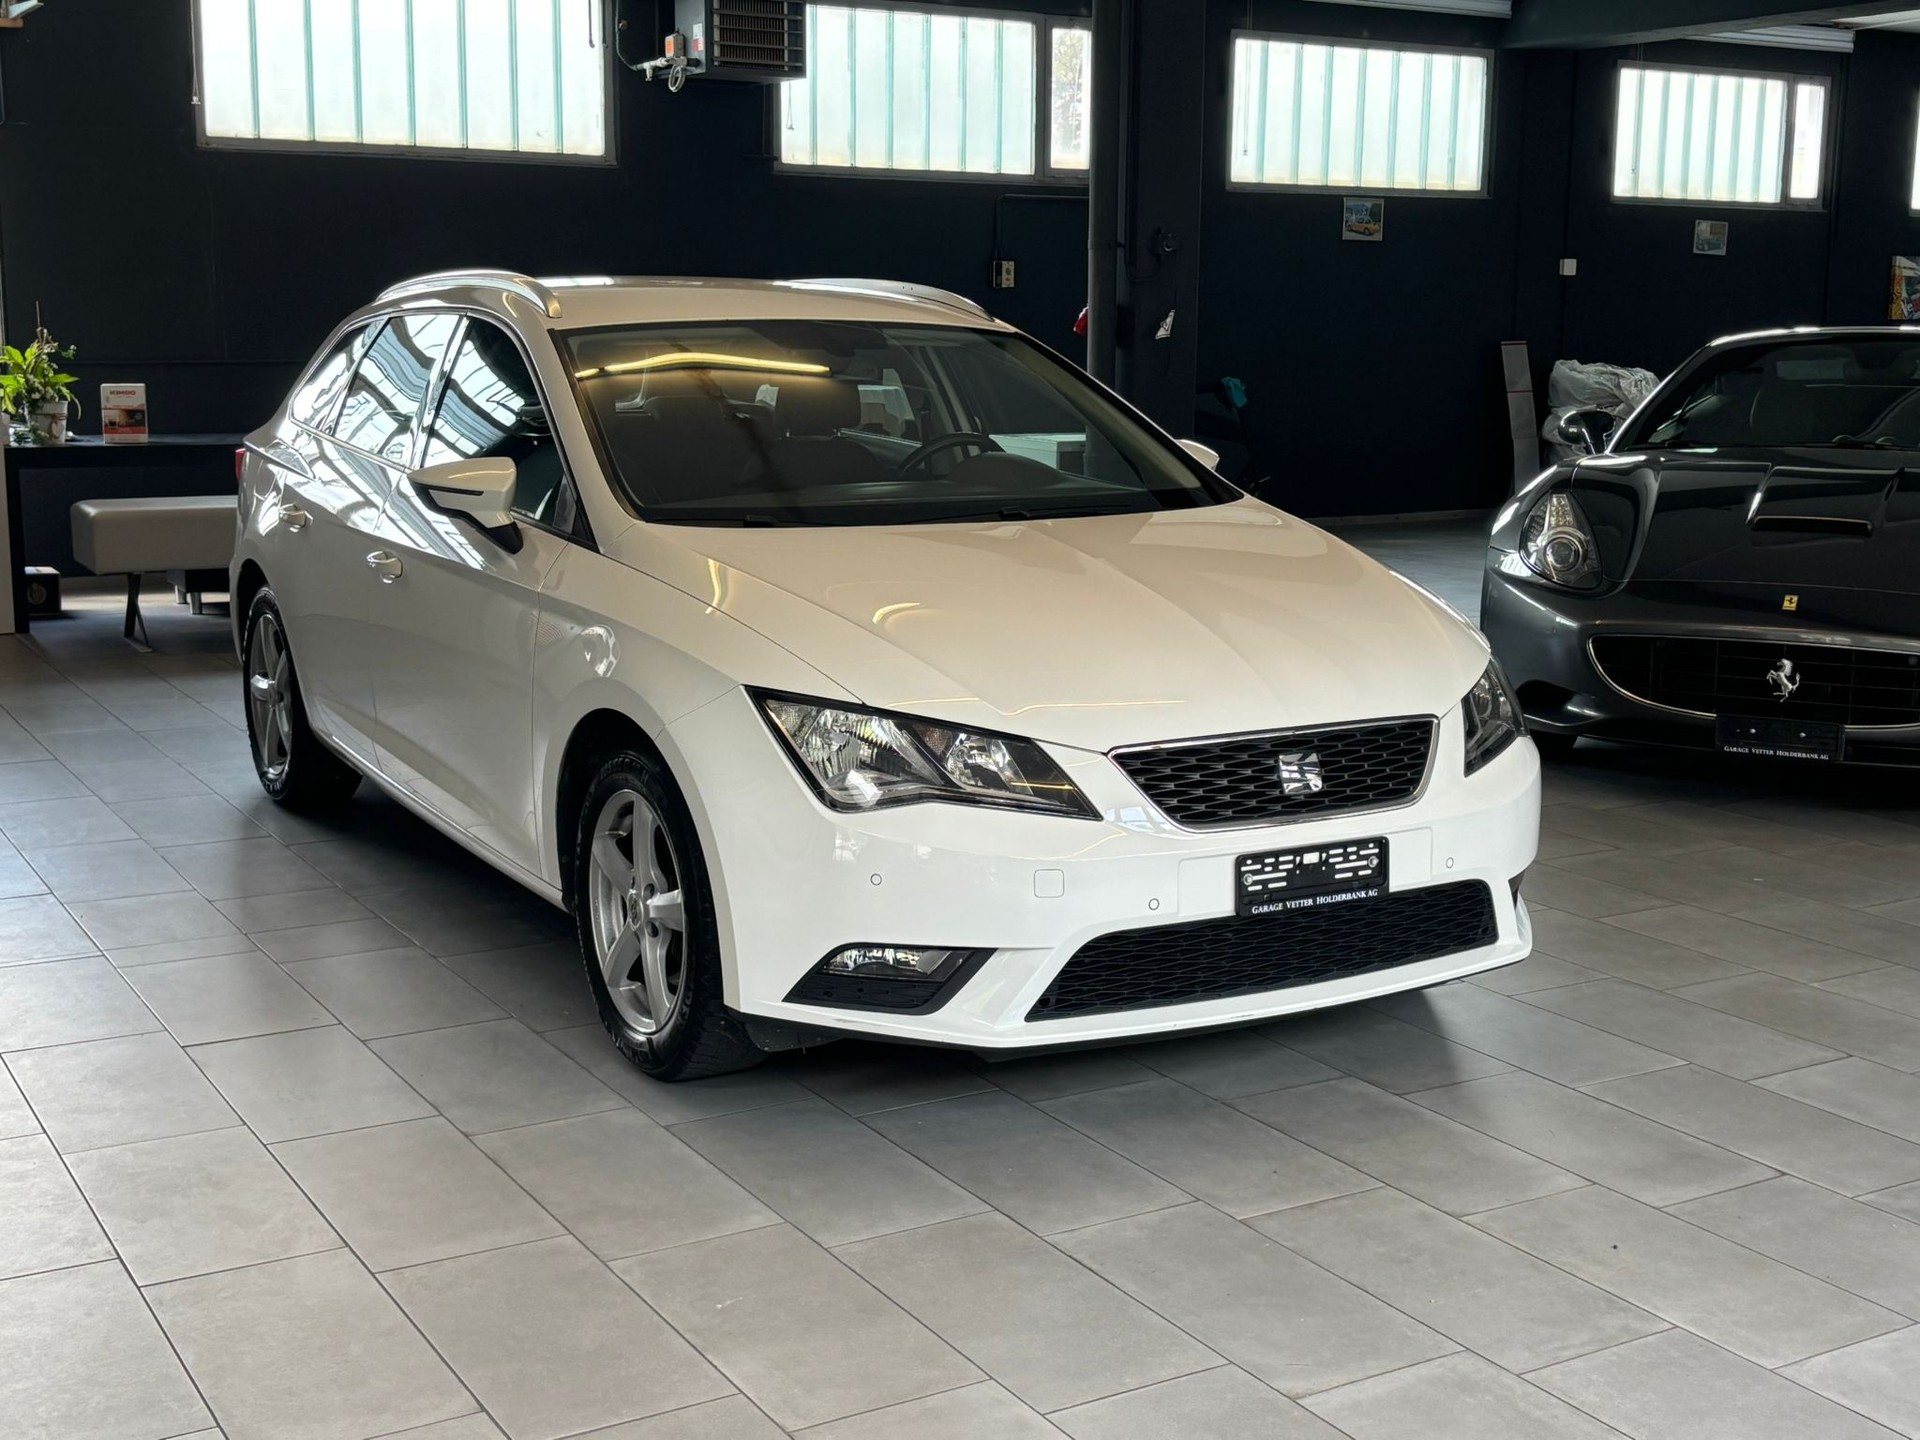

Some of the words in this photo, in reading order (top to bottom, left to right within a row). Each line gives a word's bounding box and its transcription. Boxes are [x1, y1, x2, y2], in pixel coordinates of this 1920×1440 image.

[1724, 746, 1749, 754] GARAGE
[1752, 748, 1774, 756] VETTER
[1776, 750, 1819, 759] HOLDERBANK
[1251, 902, 1284, 914] GARAGE
[1286, 897, 1313, 909] VETTER
[1316, 891, 1367, 905] HOLDERBANK
[1367, 888, 1378, 897] AG
